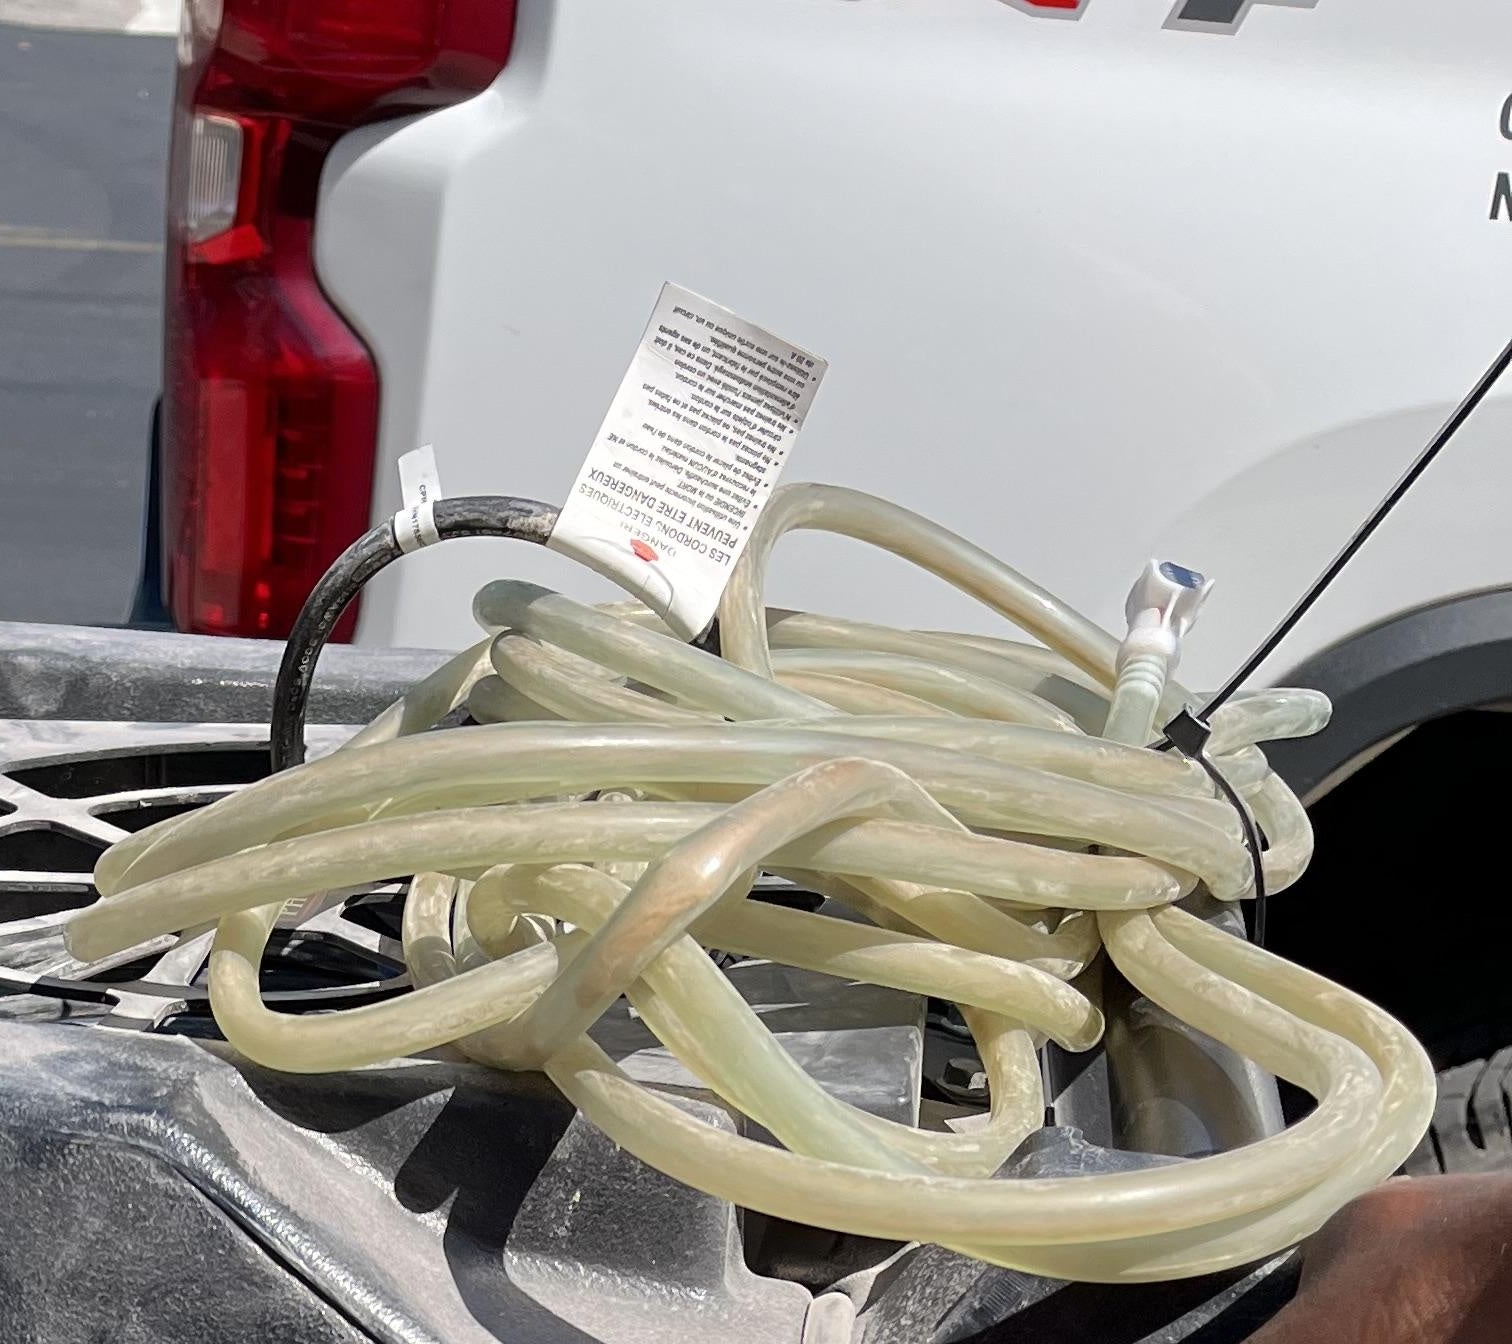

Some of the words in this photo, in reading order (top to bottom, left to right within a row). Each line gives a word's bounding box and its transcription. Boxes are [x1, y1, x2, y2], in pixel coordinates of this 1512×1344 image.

[673, 358, 696, 374] cordon
[705, 374, 721, 385] avec
[642, 383, 655, 392] pas
[697, 383, 704, 391] le
[703, 387, 716, 396] sur
[688, 405, 702, 415] pas
[713, 404, 720, 413] le
[719, 408, 732, 417] sur
[742, 405, 756, 415] pas
[698, 424, 721, 438] cordon
[728, 438, 742, 448] pas
[587, 467, 656, 509] DANGEREUX
[655, 520, 707, 553] CORDONS
[685, 516, 738, 548] PEUVENT
[708, 547, 731, 566] LES
